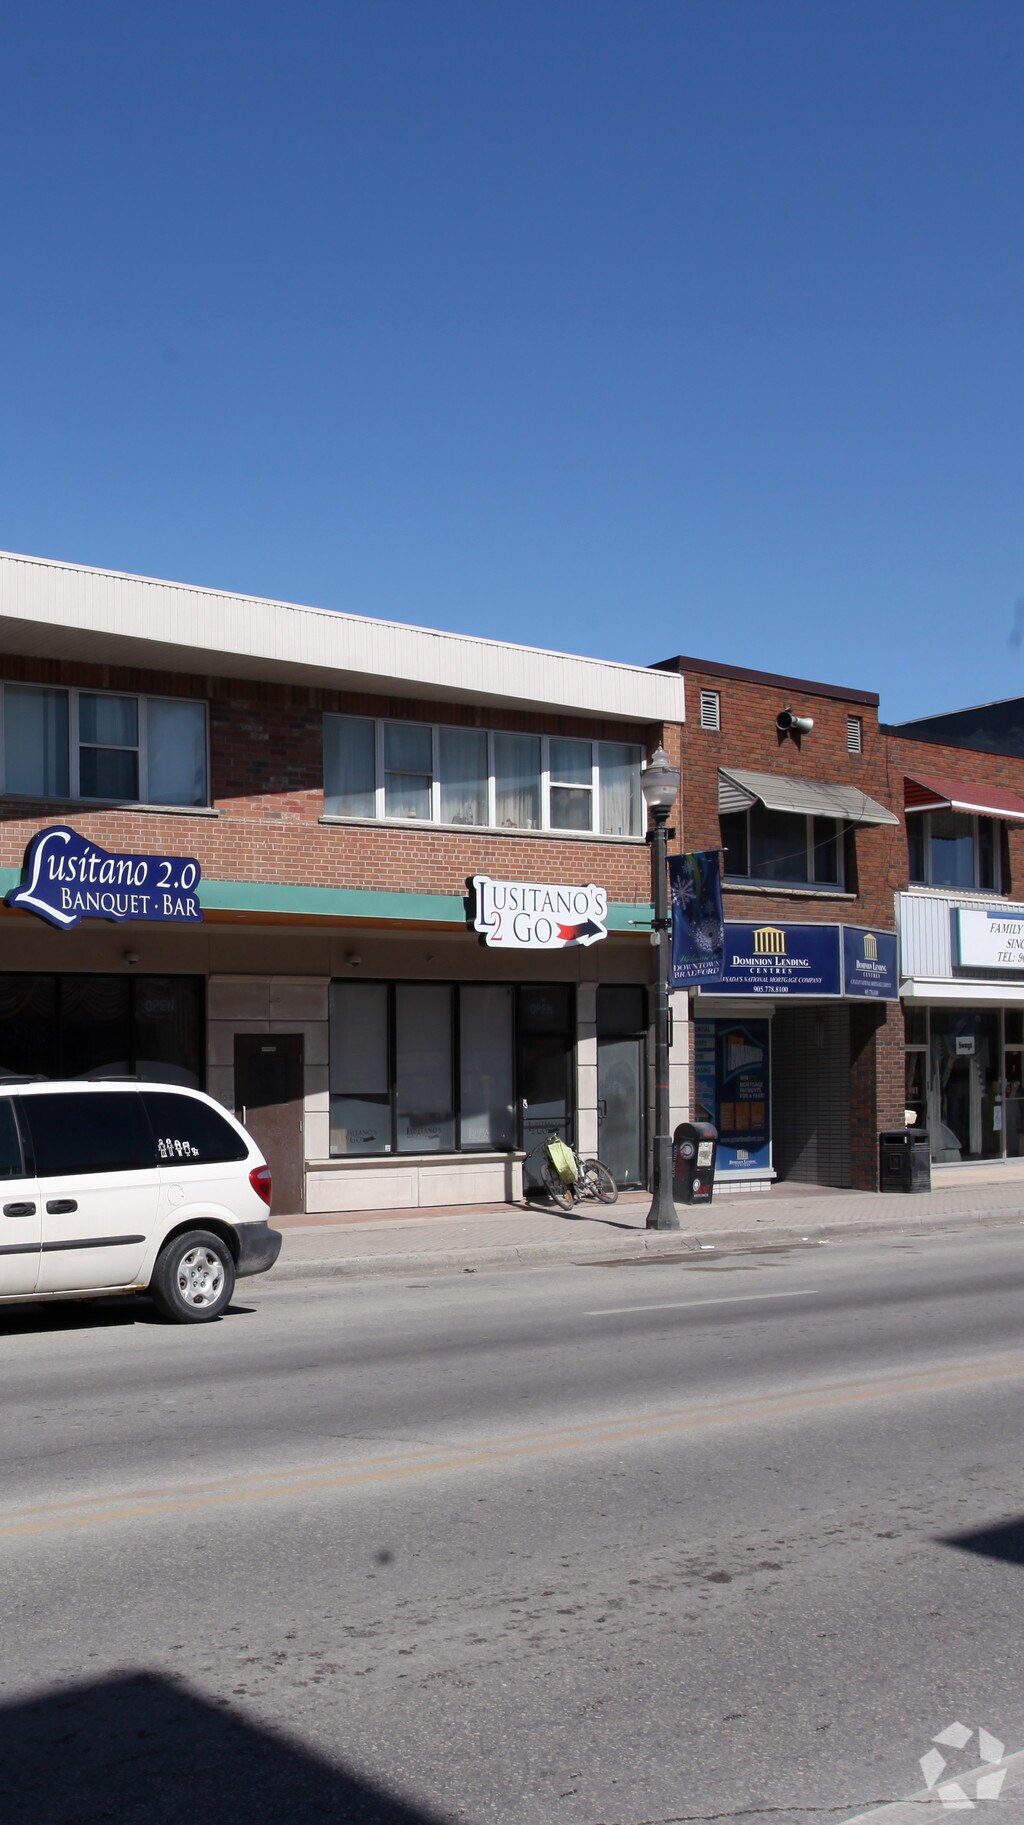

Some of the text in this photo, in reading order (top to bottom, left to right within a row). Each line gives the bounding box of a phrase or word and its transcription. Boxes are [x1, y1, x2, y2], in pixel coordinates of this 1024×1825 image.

[14, 831, 196, 924] Lusitano 2.0
[61, 887, 198, 917] BANQUET BAR
[477, 881, 605, 926] LUSITANO'S
[490, 911, 504, 941] 2
[989, 922, 1023, 935] FAMILY
[732, 955, 809, 967] DOMINION LENDING
[998, 951, 1024, 963] TEL: 9
[673, 960, 720, 972] DOWNTOWN
[674, 967, 719, 979] BRADFORD
[753, 985, 789, 993] 905.778.8100
